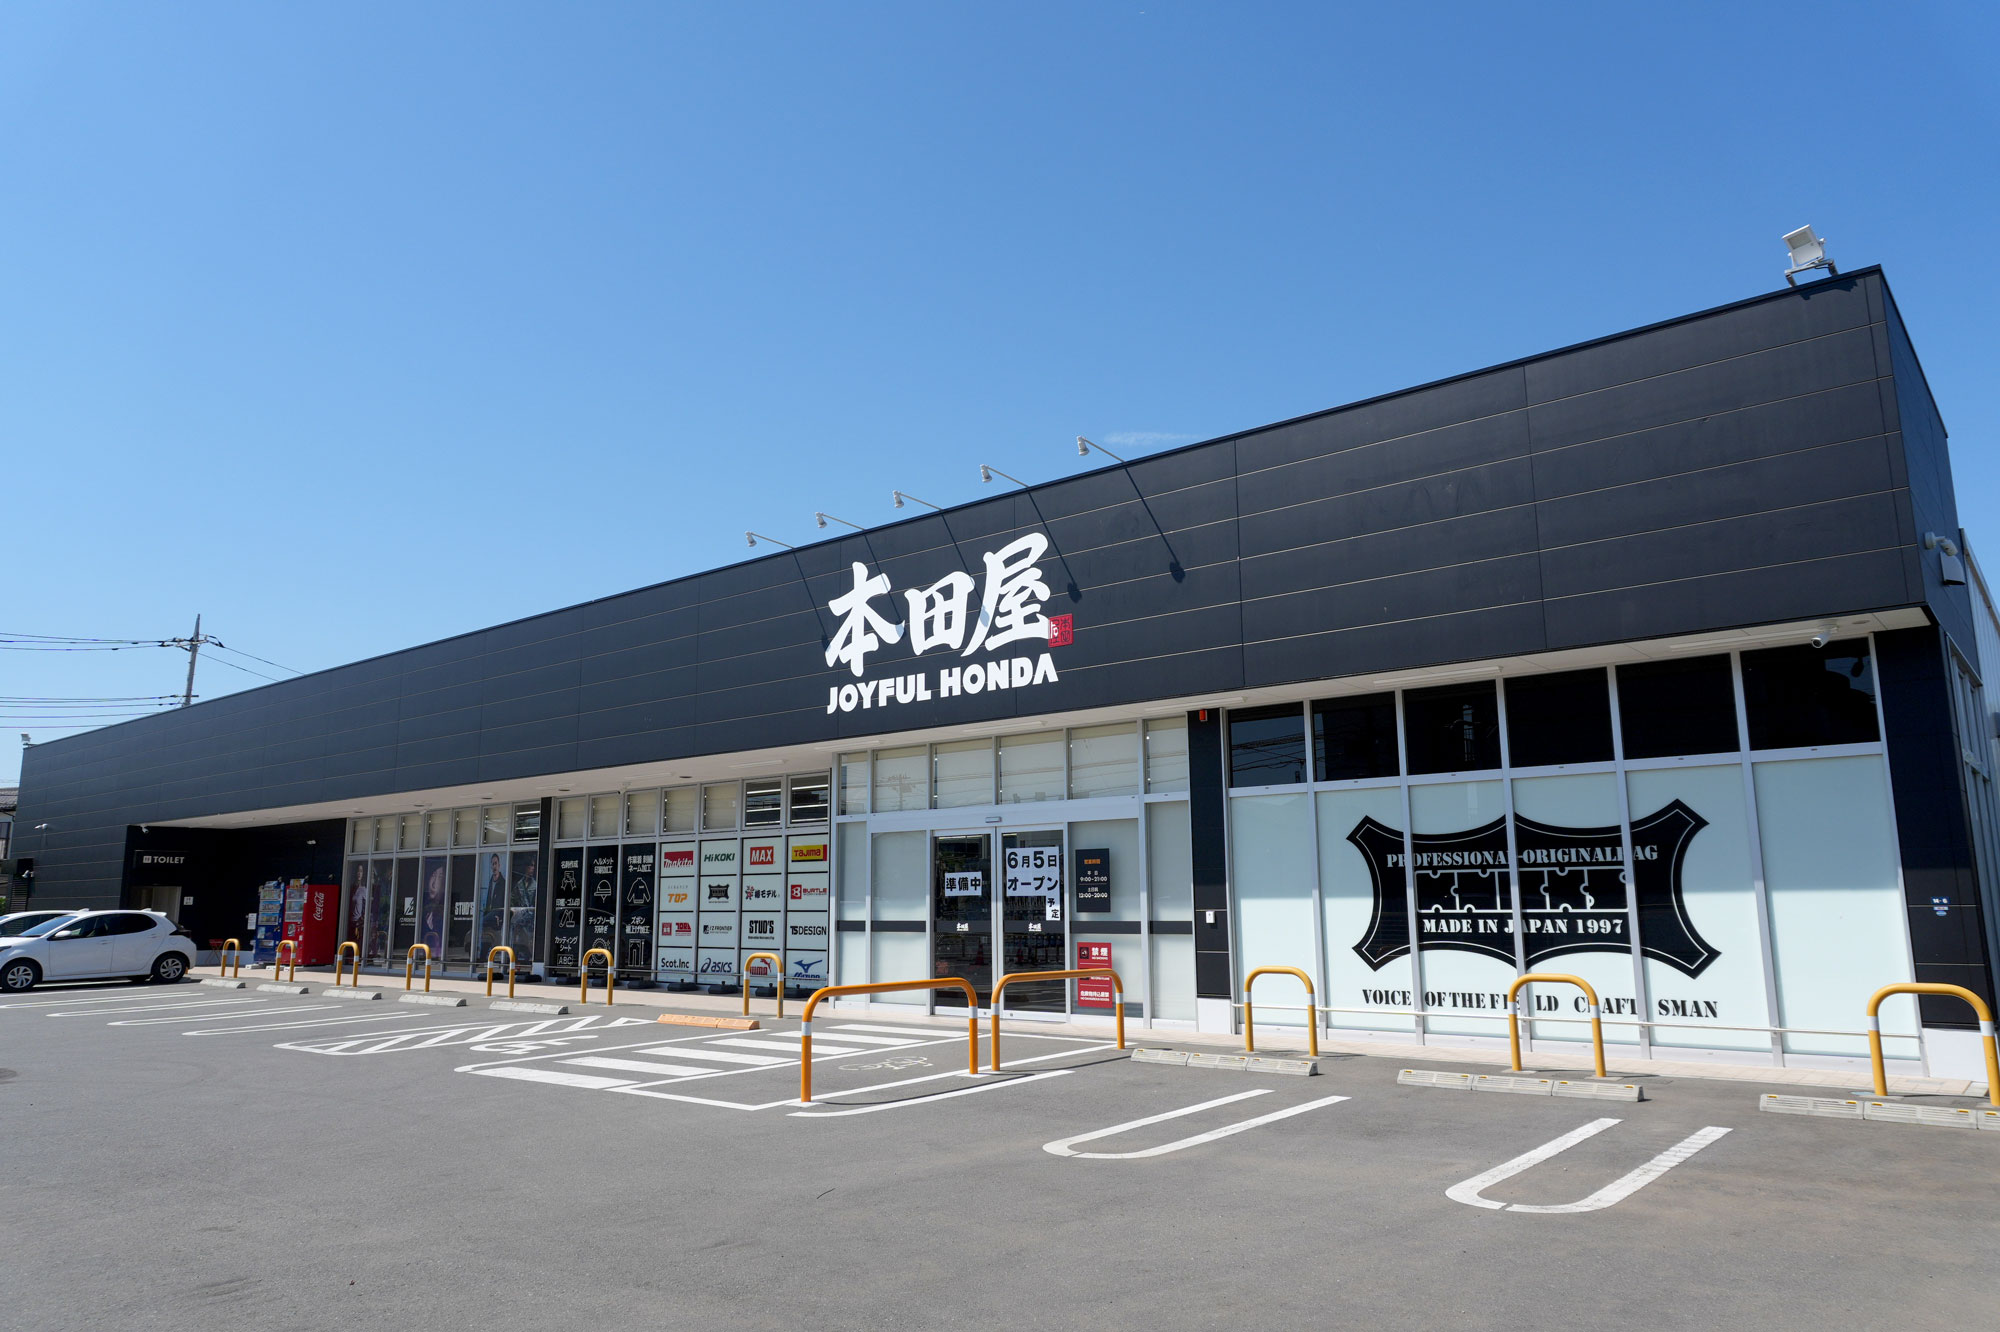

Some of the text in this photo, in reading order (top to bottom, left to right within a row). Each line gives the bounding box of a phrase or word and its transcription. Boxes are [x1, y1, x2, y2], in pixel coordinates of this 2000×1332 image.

[825, 532, 1051, 677] 本田屋
[827, 653, 1059, 714] JOYFUL HONDA
[153, 856, 184, 864] TOILET
[751, 849, 772, 862] MAX
[1007, 850, 1057, 869] 6月5日
[946, 876, 981, 892] 準備中
[1007, 875, 1058, 892] オープン
[313, 891, 325, 921] Coca-Cola
[667, 893, 688, 903] TOP
[1047, 898, 1060, 919] 予定
[748, 920, 774, 934] STUD'S
[1422, 918, 1473, 934] MADE
[1477, 918, 1499, 934] IN
[1576, 918, 1623, 934] 1997
[1362, 989, 1412, 1006] VOICE
[1424, 991, 1447, 1007] OF
[1448, 992, 1487, 1009] THE
